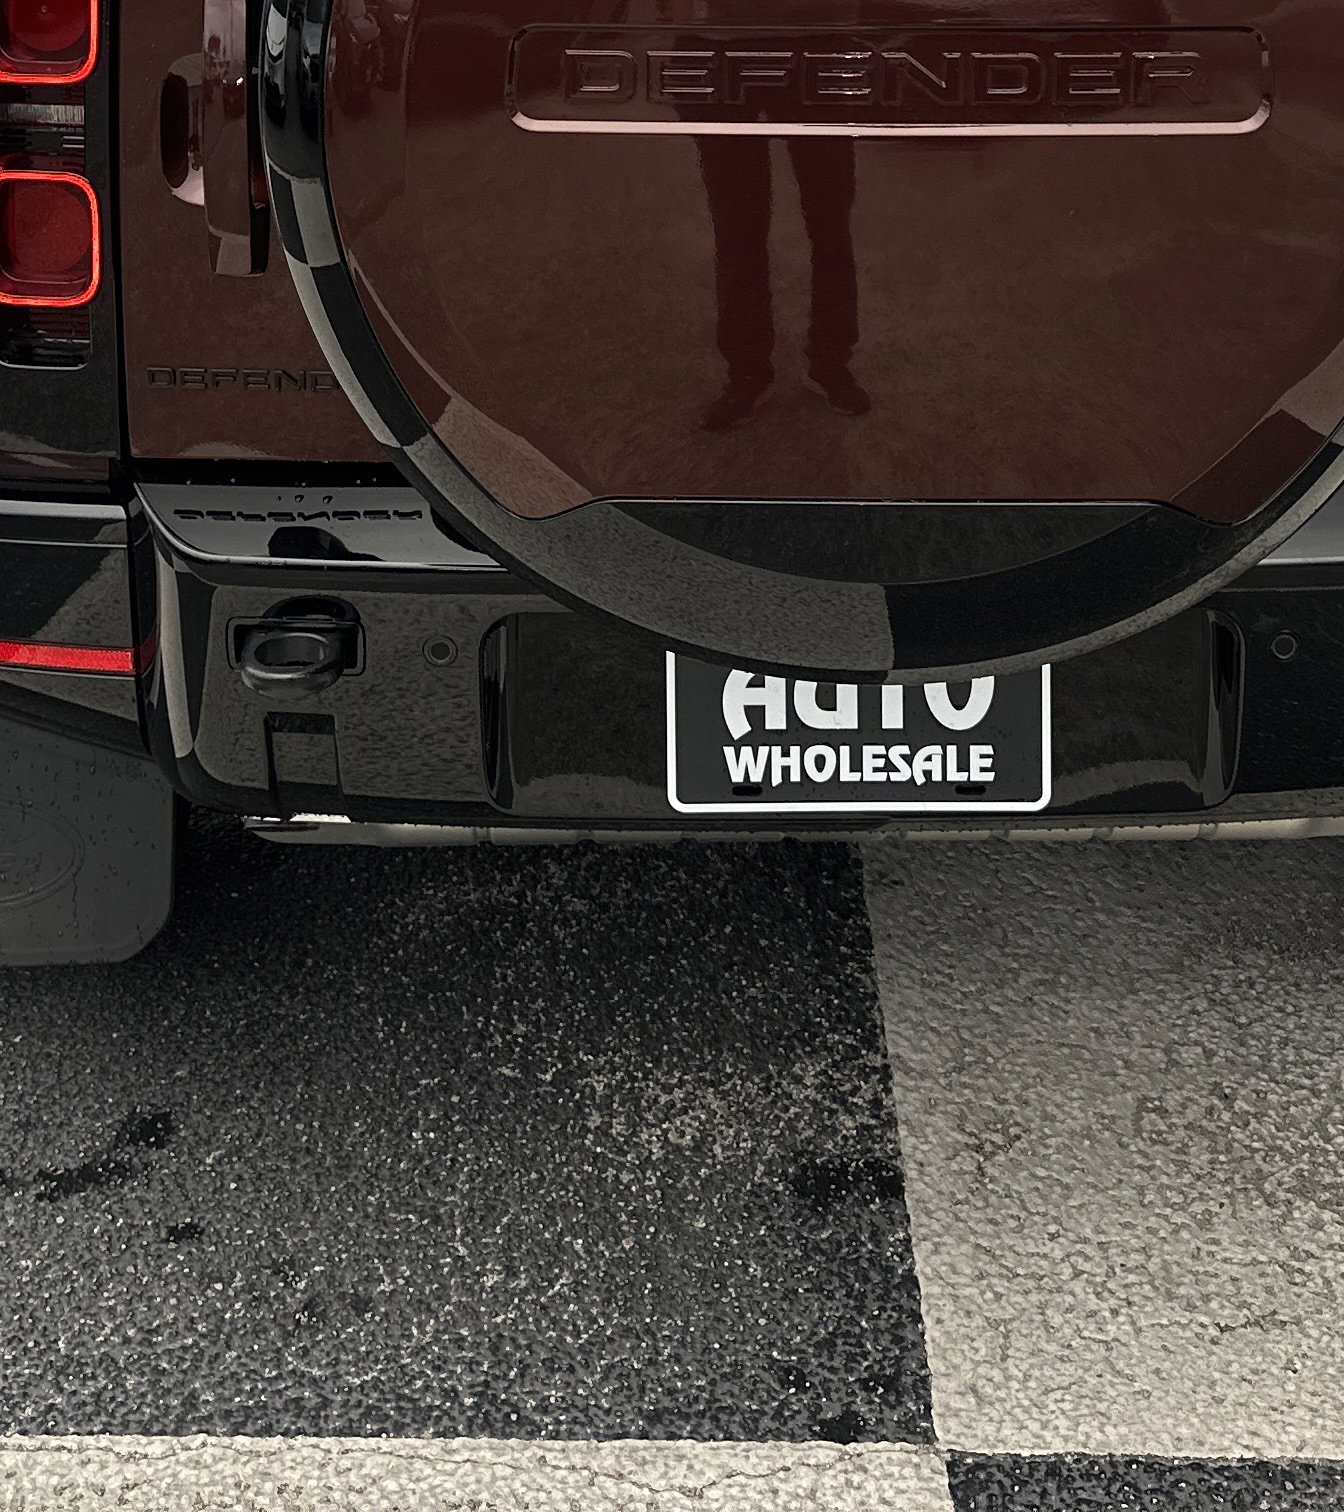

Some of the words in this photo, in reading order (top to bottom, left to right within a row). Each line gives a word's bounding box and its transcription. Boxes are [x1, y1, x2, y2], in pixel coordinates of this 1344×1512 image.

[564, 50, 1211, 105] DEFENDER
[146, 366, 341, 392] DEFEND
[722, 744, 996, 787] WHOLESALE
